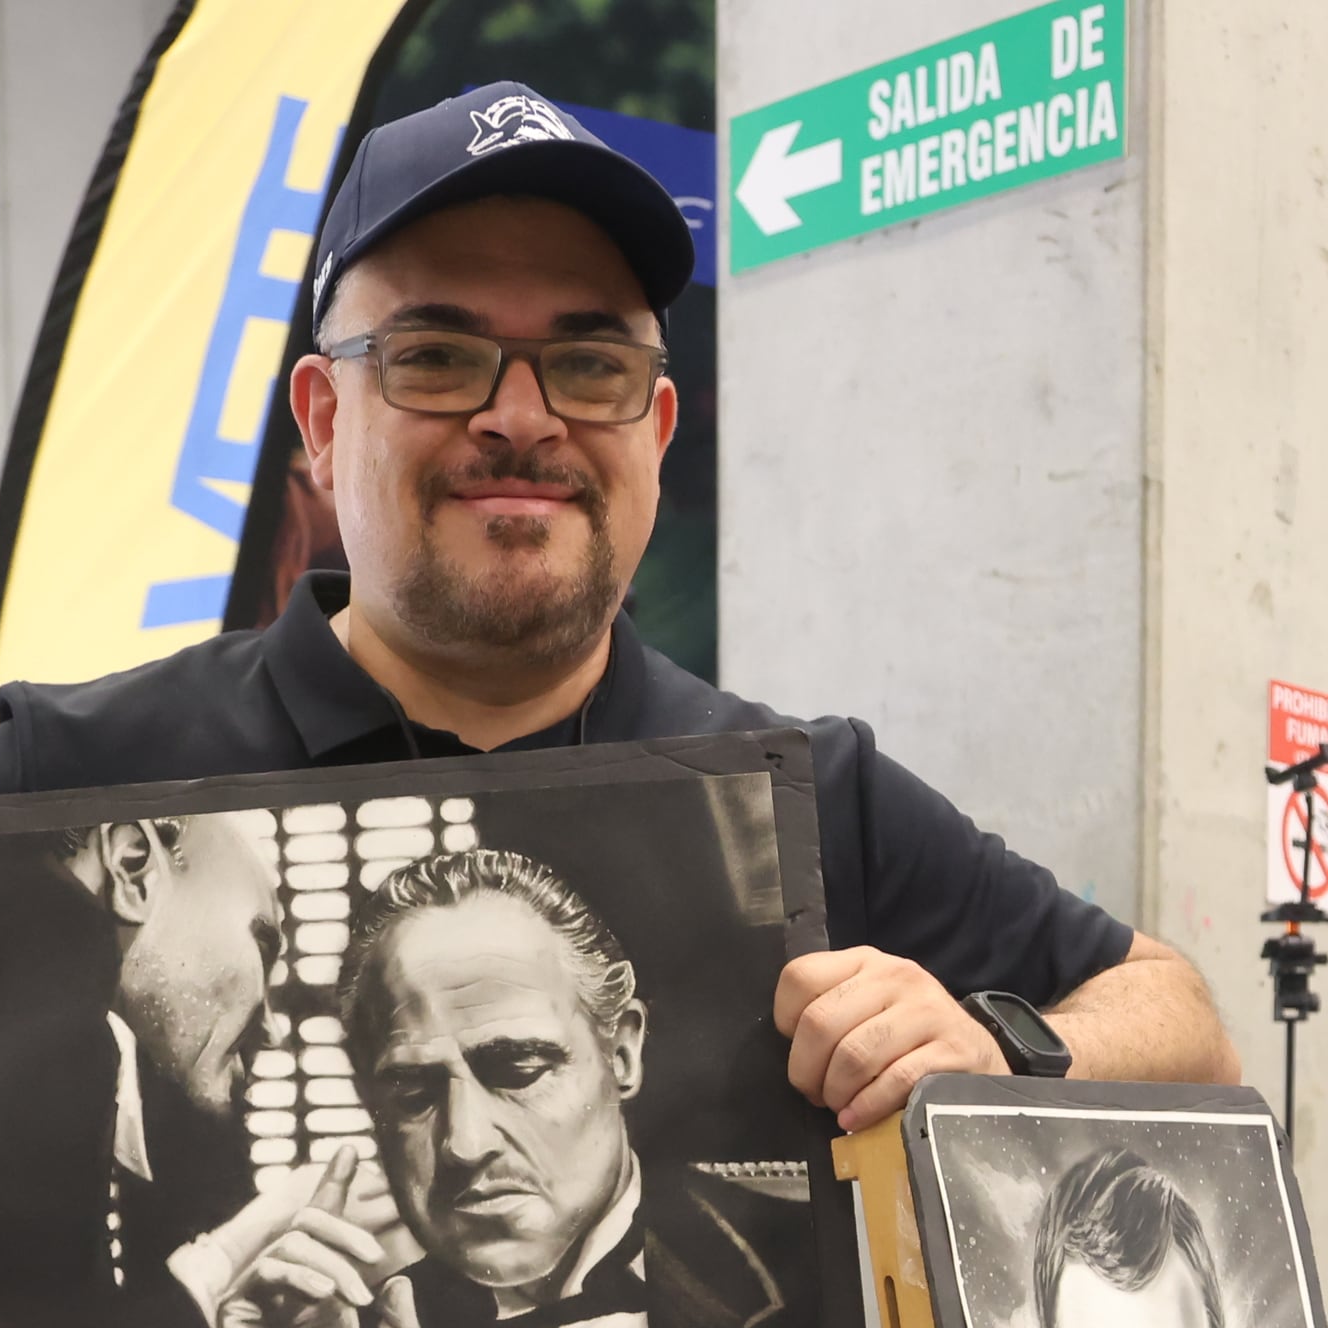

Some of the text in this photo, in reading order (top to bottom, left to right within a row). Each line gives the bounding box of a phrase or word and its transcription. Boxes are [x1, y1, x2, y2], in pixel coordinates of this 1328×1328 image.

[867, 3, 1105, 140] SALIDA DE
[860, 80, 1118, 216] EMERGENCIA
